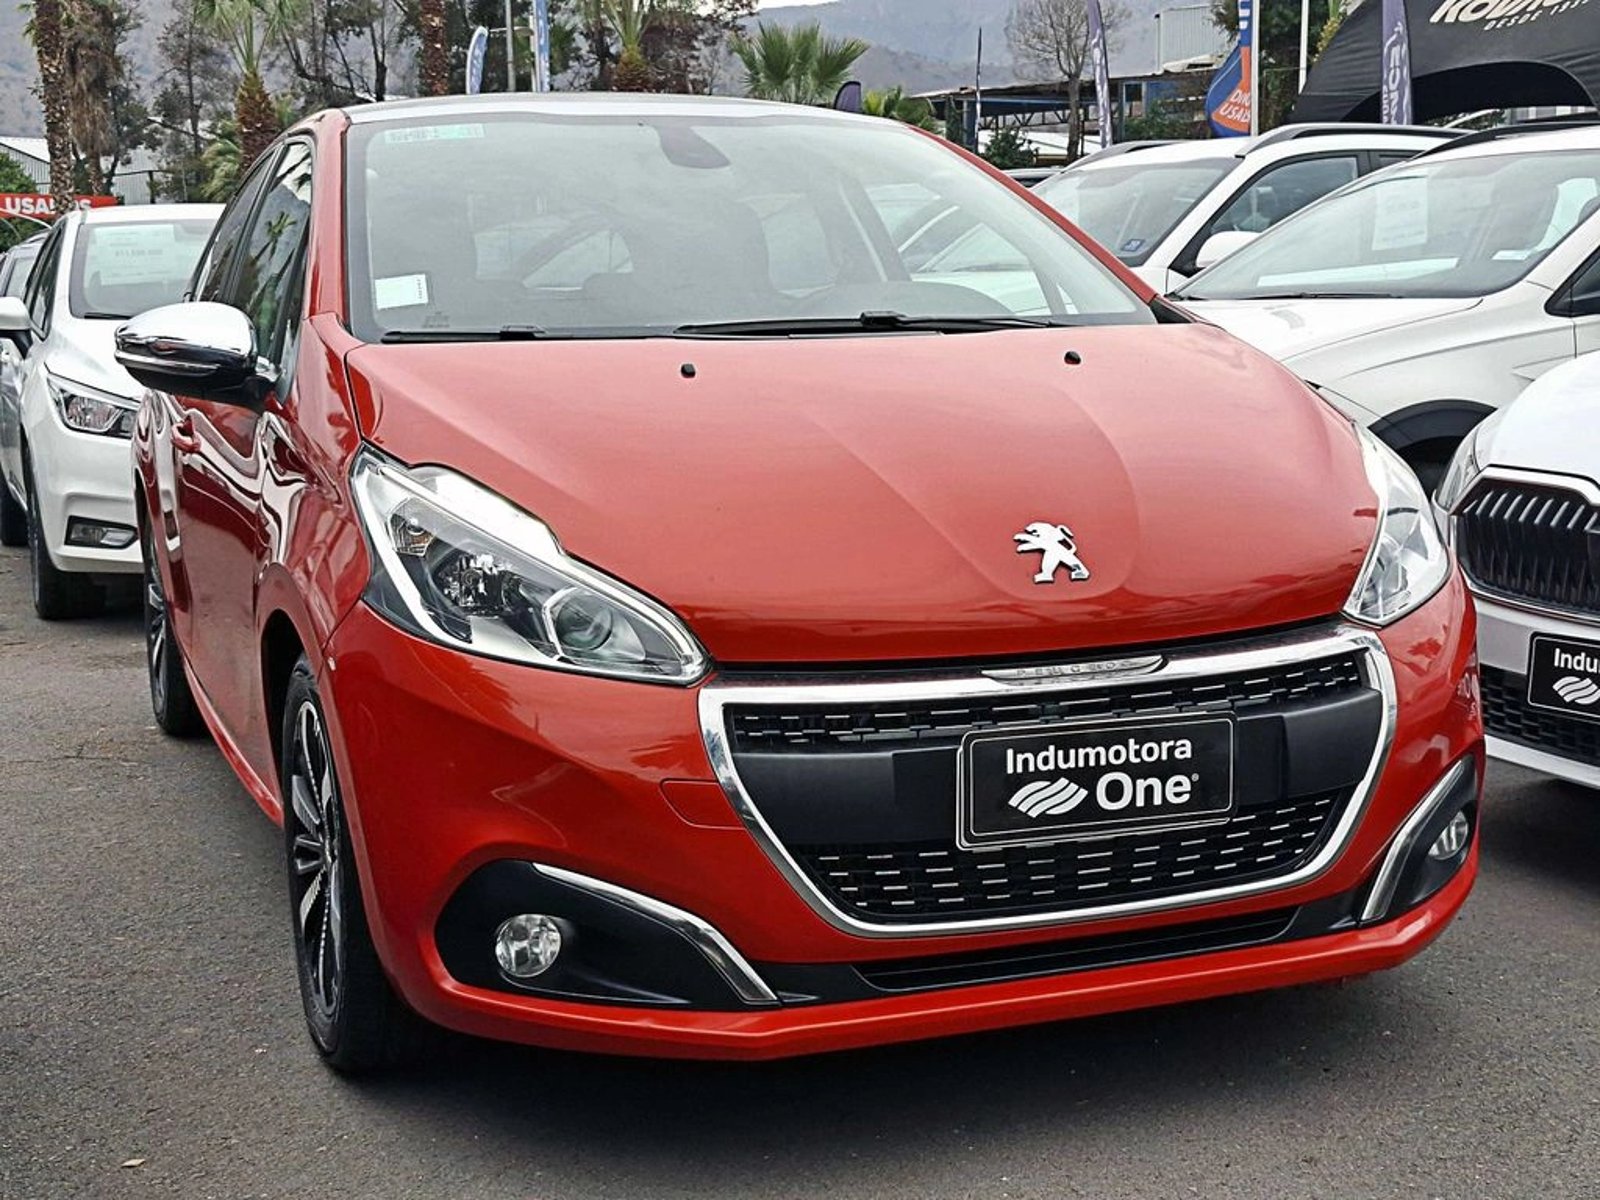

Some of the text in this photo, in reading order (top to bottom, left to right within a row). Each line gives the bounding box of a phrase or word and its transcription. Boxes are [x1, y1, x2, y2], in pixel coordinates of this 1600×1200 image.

[1429, 0, 1564, 23] KOV
[1483, 15, 1542, 31] DESDE
[5, 197, 92, 215] USAS
[1554, 647, 1600, 674] Indu
[1006, 738, 1192, 775] Indumotora
